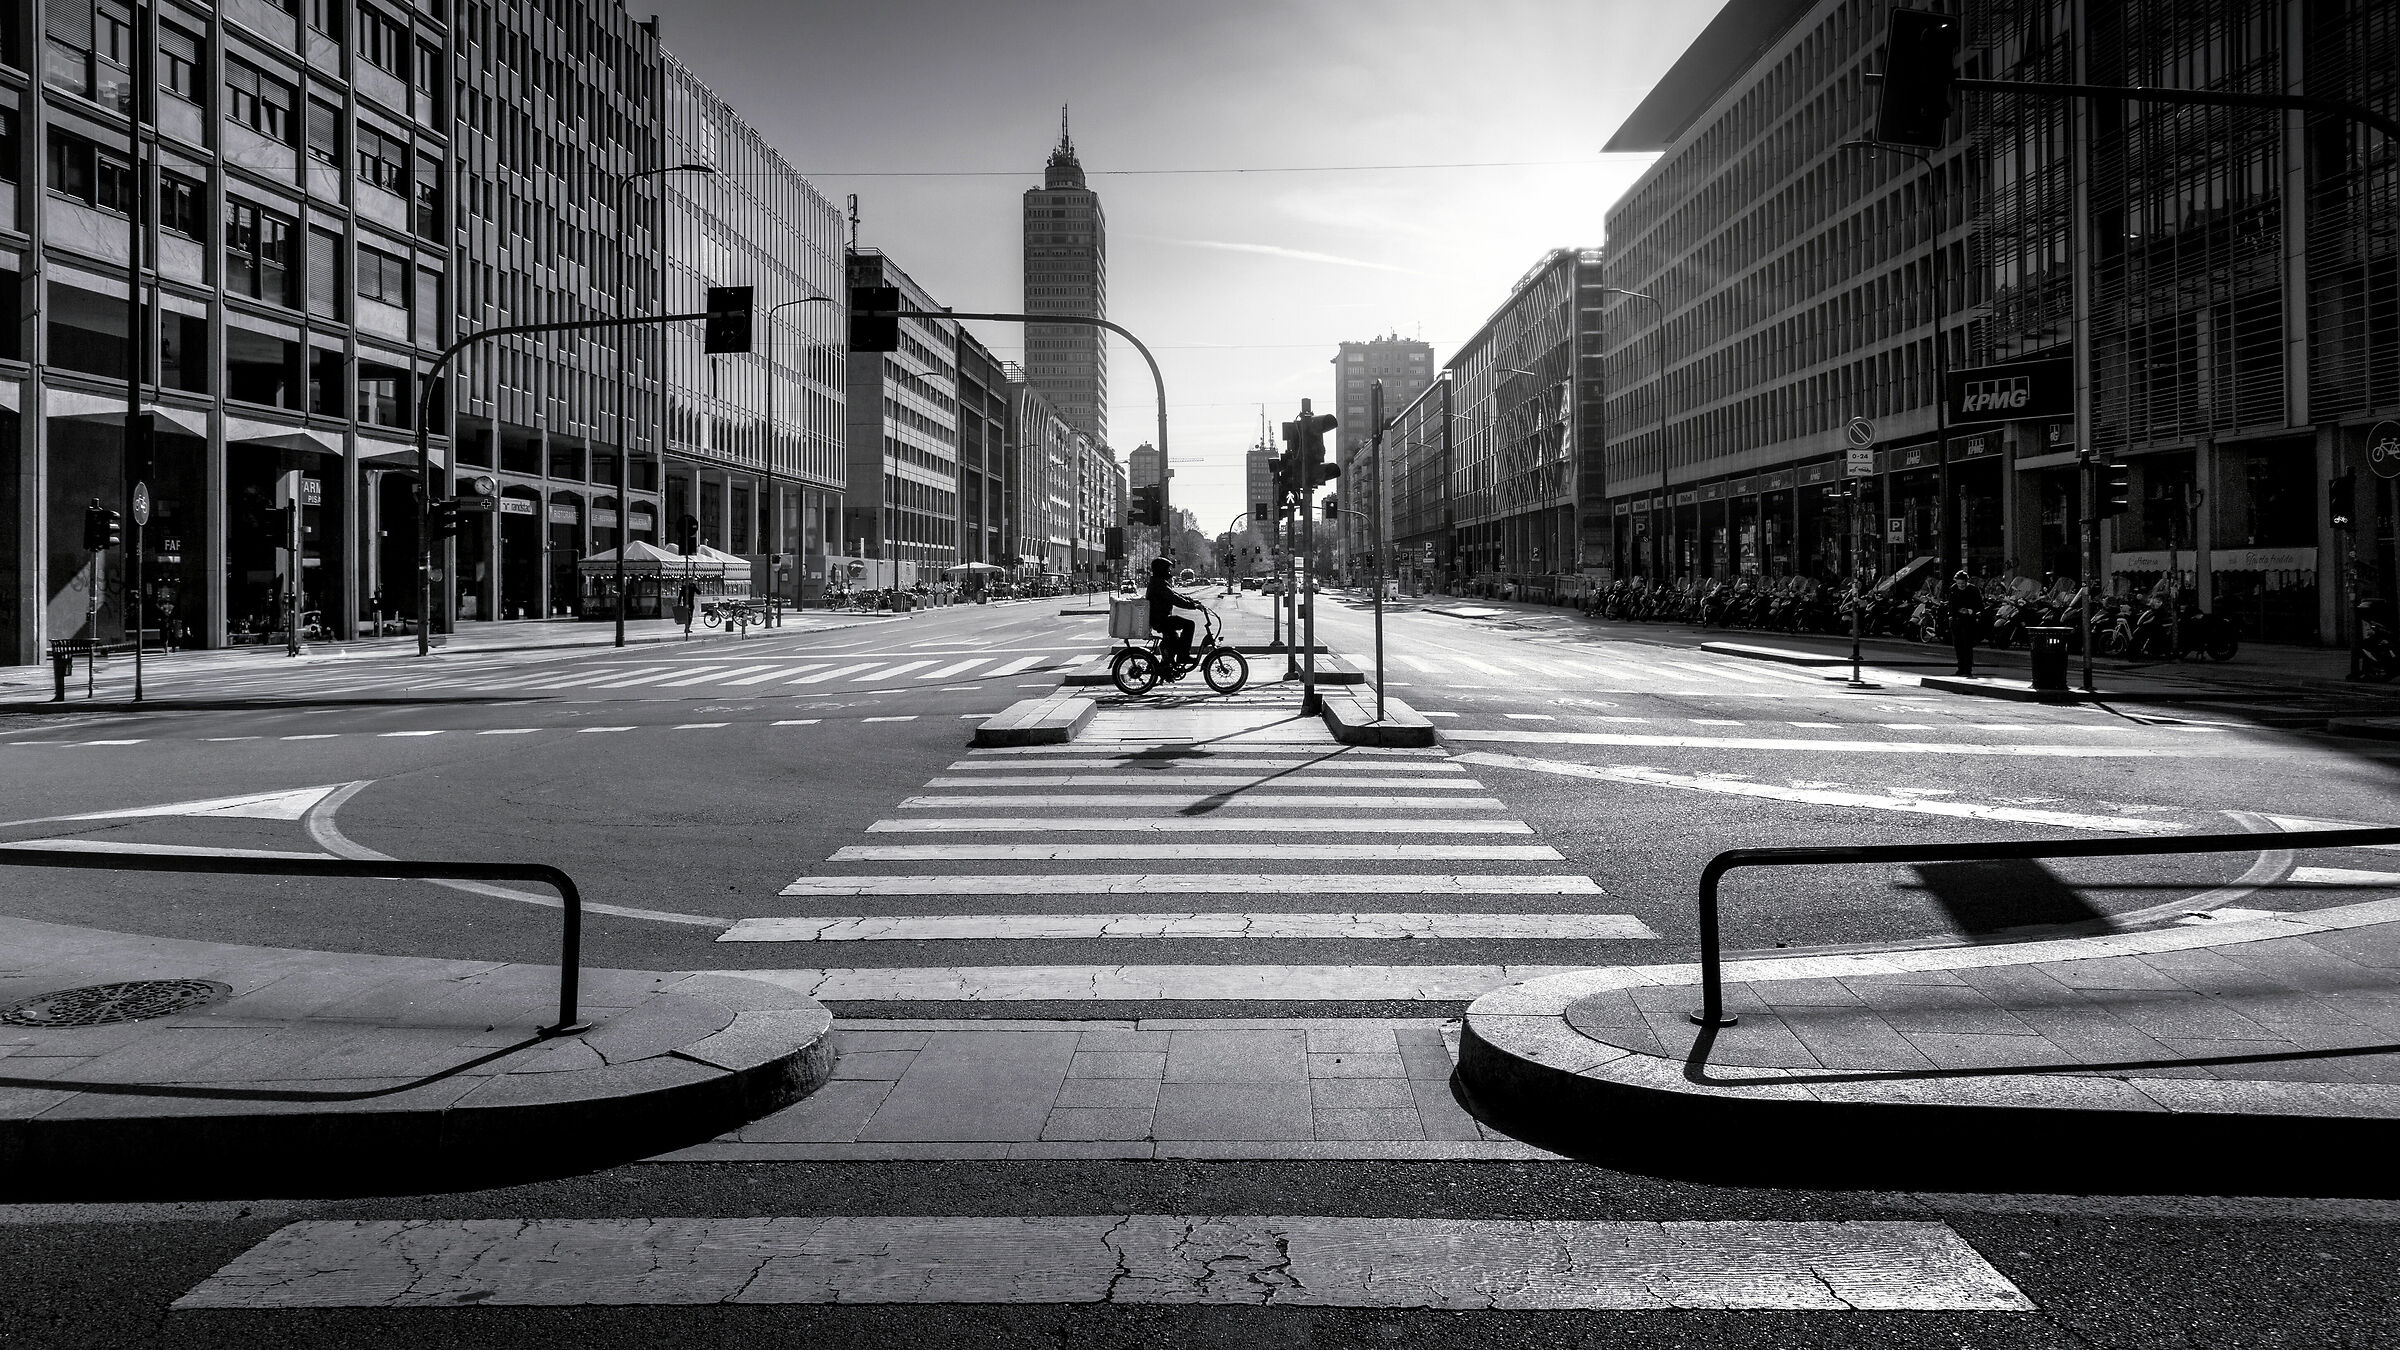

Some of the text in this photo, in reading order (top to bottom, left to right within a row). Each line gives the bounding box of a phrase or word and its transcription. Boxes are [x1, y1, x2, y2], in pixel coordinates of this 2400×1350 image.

[1962, 388, 2028, 413] KPMG
[1635, 523, 1646, 535] P
[1892, 521, 1900, 531] P
[1425, 542, 1433, 551] P
[1402, 552, 1408, 560] P
